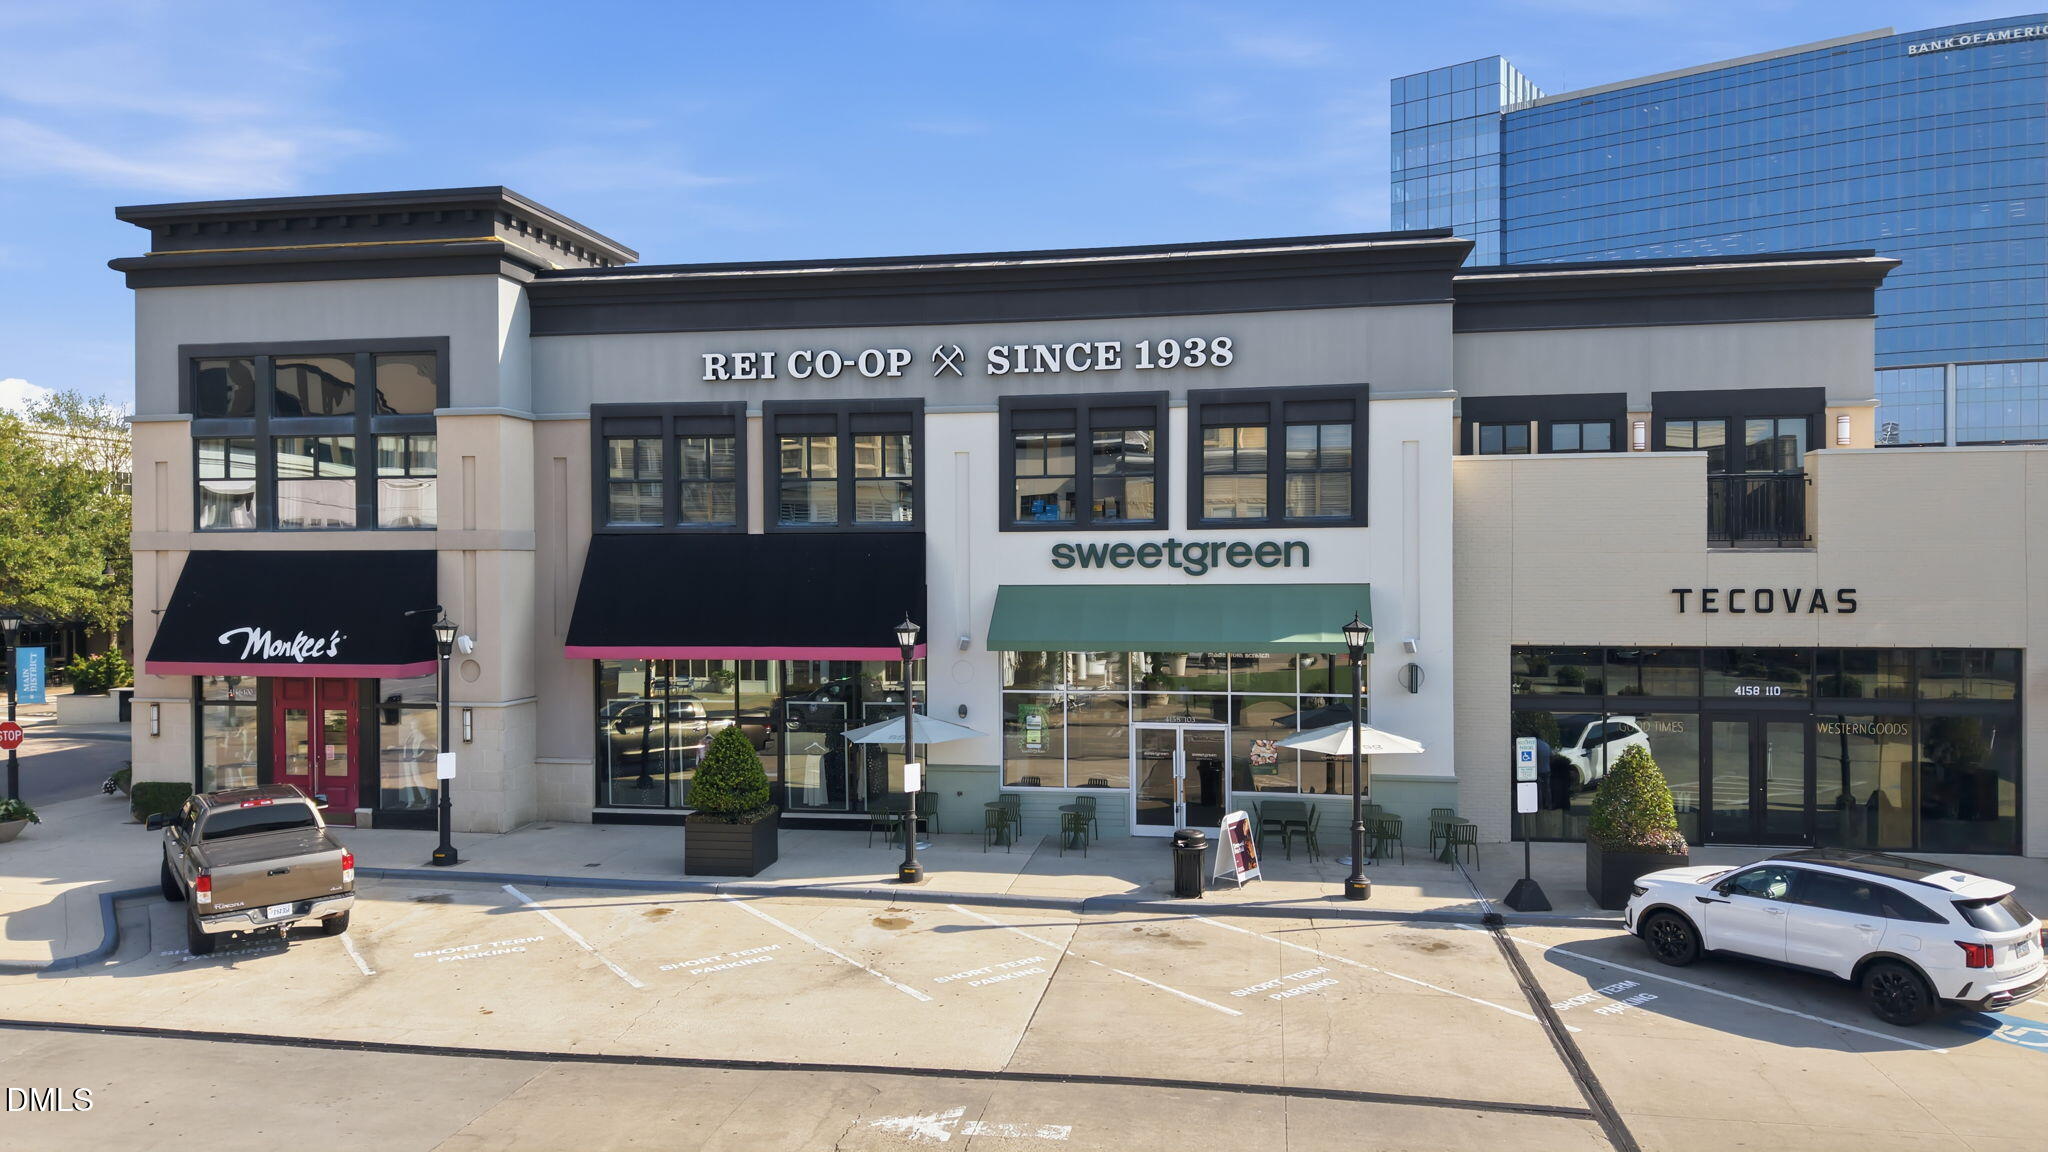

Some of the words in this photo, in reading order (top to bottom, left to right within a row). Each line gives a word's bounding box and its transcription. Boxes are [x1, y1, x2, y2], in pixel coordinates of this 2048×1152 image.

[1908, 38, 1955, 55] BANK
[1959, 33, 1981, 46] OF
[702, 352, 776, 381] REI
[787, 348, 912, 379] CO-OP
[987, 341, 1122, 375] SINCE
[1134, 336, 1235, 369] 1938
[1051, 538, 1311, 577] sweetgreen
[1671, 588, 1858, 614] TECOVAS
[218, 627, 341, 663] Monkee's
[1734, 686, 1760, 696] 4158
[1765, 686, 1781, 696] 110
[1655, 721, 1684, 733] TIMES
[1868, 723, 1908, 736] GOODS
[659, 955, 722, 972] SHORT
[728, 943, 781, 958] TERM
[690, 955, 774, 975] PARKING
[933, 966, 993, 984] SHORT
[995, 955, 1047, 970] TERM
[967, 966, 1047, 988] PARKING
[1230, 978, 1285, 997] SHORT
[1282, 966, 1331, 981] TERM
[1269, 978, 1340, 1000] PARKING
[1550, 992, 1602, 1011] SHORT
[1595, 980, 1641, 995] TERM
[1593, 992, 1659, 1016] PARKING
